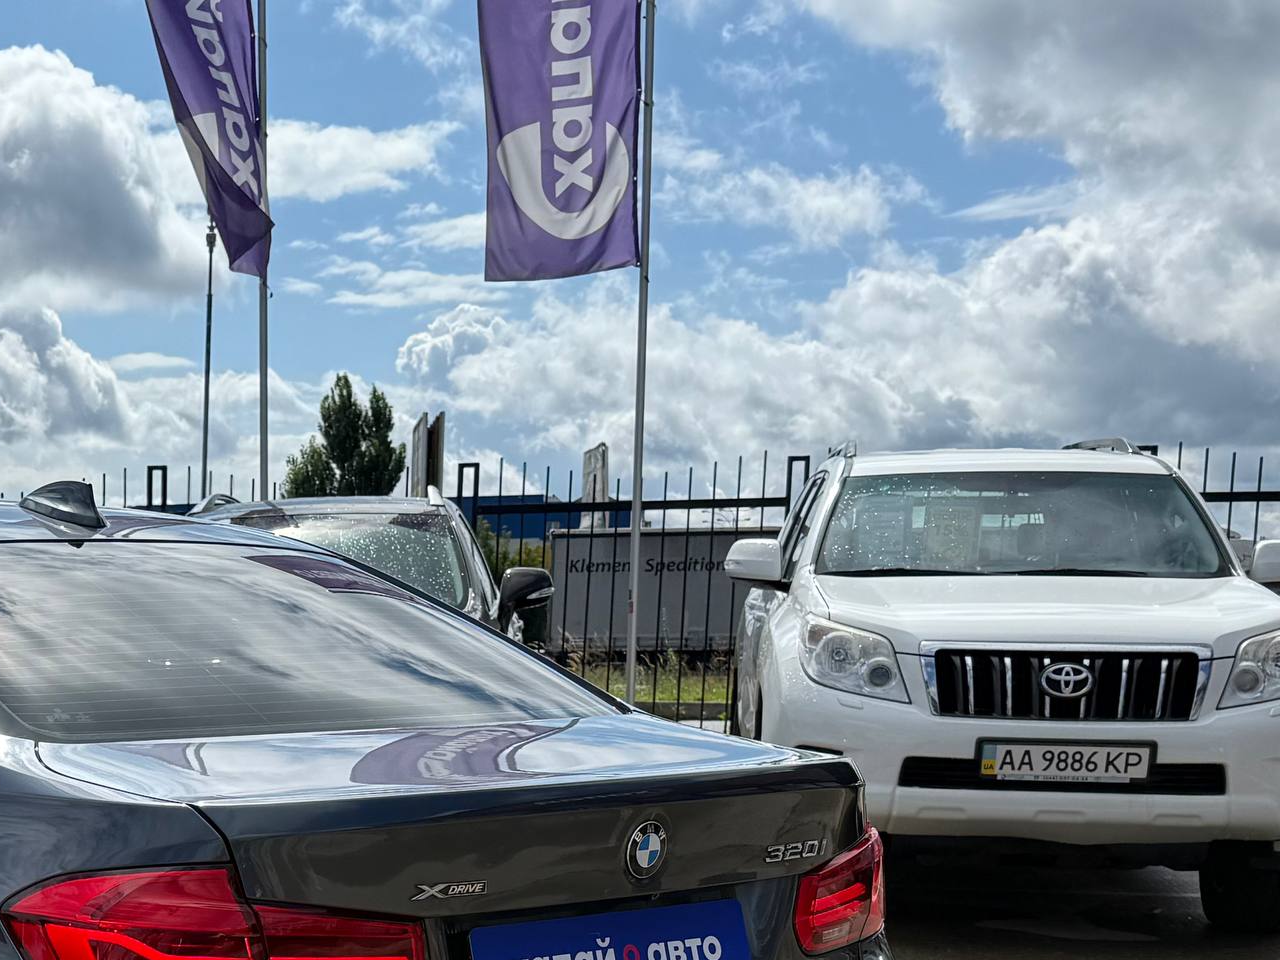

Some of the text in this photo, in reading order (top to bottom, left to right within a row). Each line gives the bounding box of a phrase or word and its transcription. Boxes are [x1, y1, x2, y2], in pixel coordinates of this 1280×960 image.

[569, 558, 631, 573] Klemen
[998, 749, 1142, 774] AA 9886 KP
